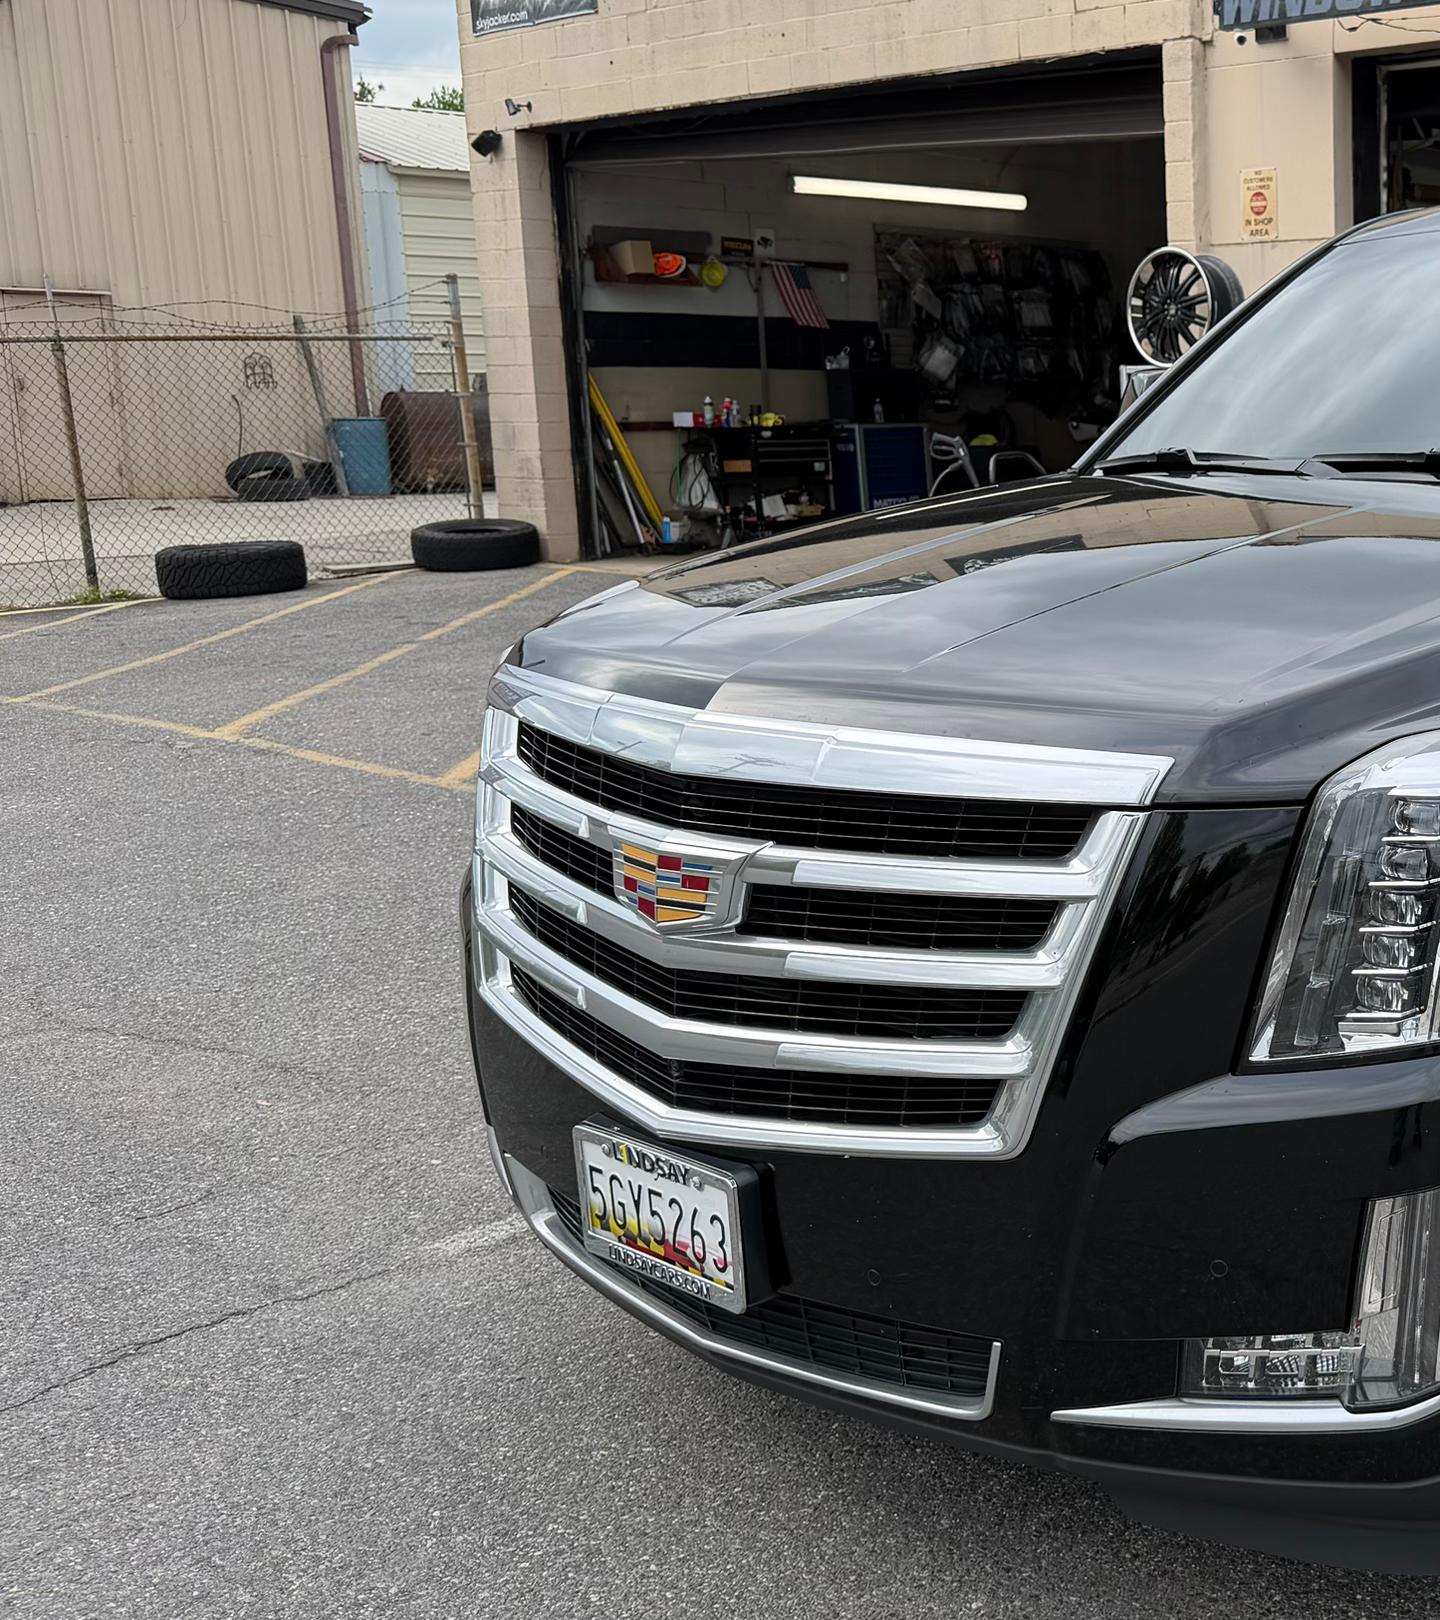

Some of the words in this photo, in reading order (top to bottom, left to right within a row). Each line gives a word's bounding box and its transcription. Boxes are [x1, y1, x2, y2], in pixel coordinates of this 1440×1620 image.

[476, 11, 528, 30] skyjacker.com
[1223, 0, 1403, 25] WIN
[1249, 229, 1270, 237] AREA
[1254, 217, 1274, 226] SHOP
[611, 1141, 691, 1187] LINDSAY
[589, 1165, 729, 1274] 5GY5263
[608, 1243, 711, 1300] LINDSAYCARS.COM
